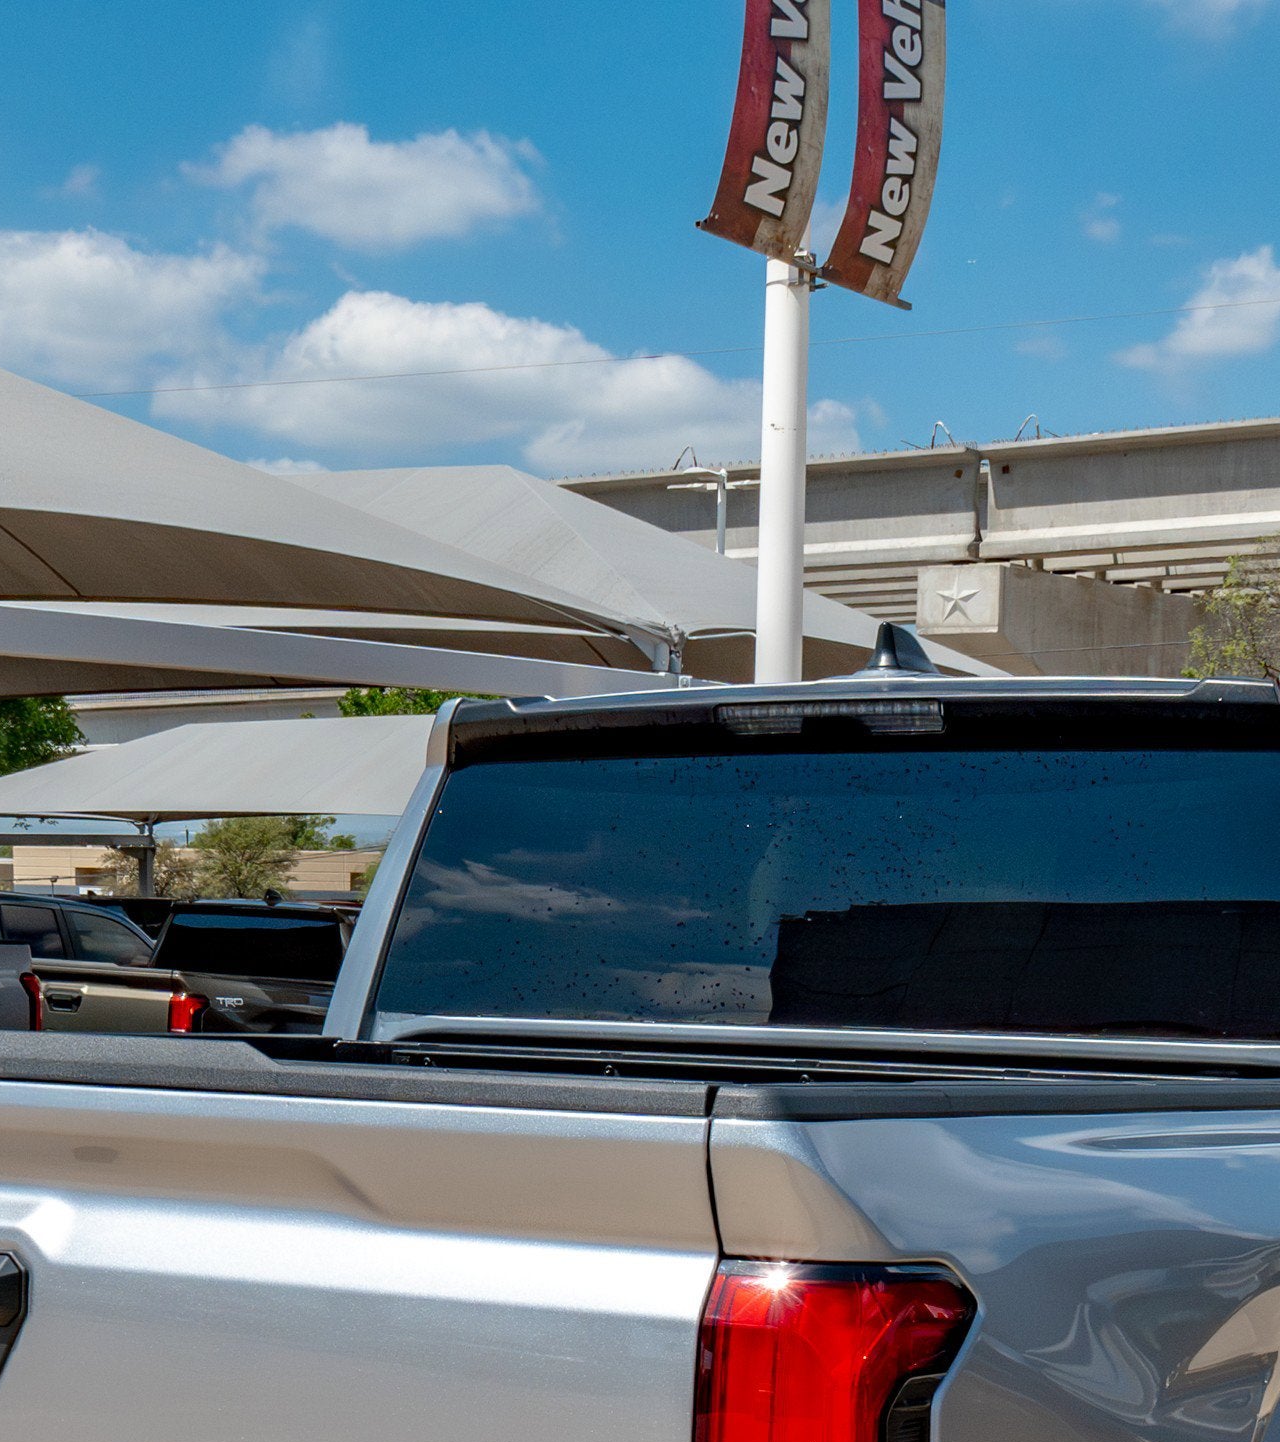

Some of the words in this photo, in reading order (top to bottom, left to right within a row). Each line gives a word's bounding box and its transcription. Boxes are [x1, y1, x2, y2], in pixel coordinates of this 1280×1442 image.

[770, 0, 808, 39] V
[744, 56, 806, 217] New
[859, 117, 918, 264] New
[215, 997, 244, 1008] TRD
